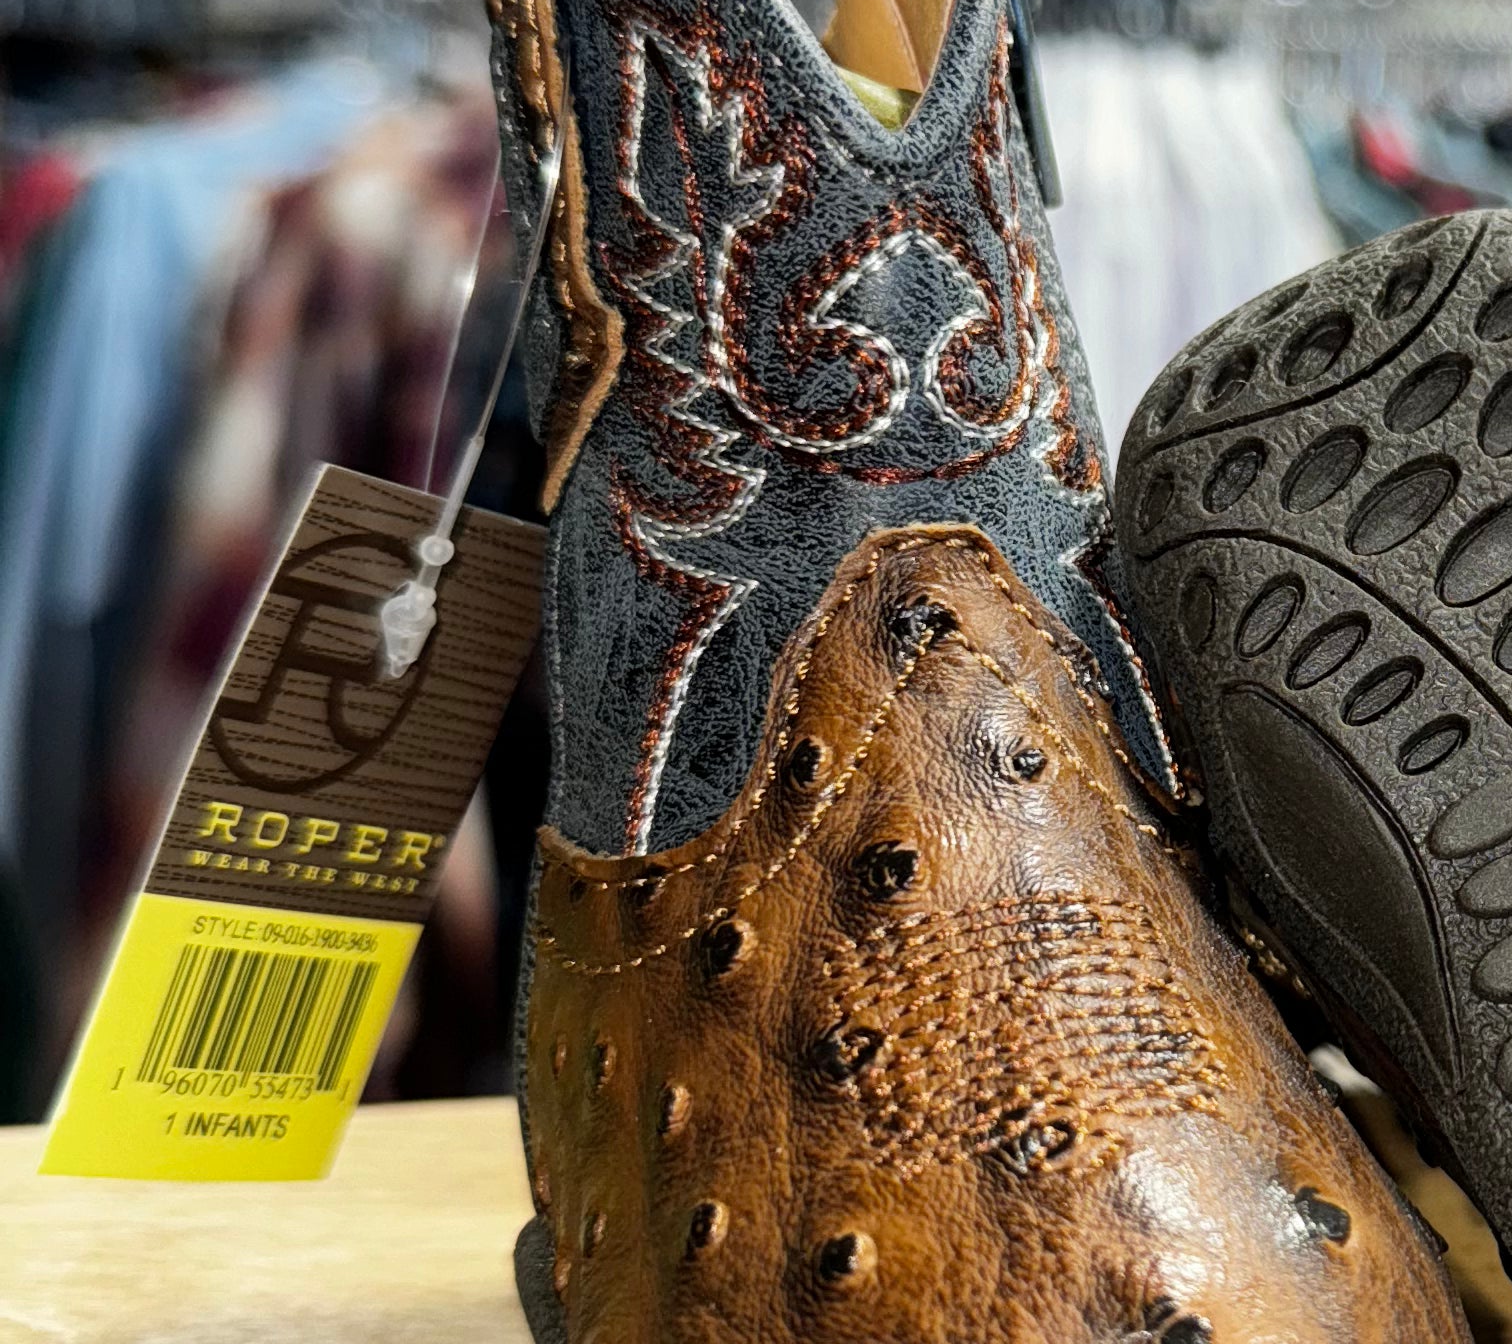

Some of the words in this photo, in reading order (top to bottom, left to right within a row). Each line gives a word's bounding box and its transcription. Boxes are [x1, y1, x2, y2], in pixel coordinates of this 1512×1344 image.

[199, 801, 433, 870] ROPER
[191, 849, 271, 875] WEAR
[285, 863, 338, 883] THE
[352, 871, 420, 894] WEST
[110, 1066, 127, 1091] 1
[160, 1069, 238, 1098] 96070
[249, 1074, 316, 1101] 55473
[338, 1079, 353, 1102] 1
[165, 1111, 178, 1136] 1
[183, 1111, 291, 1140] INFANTS
